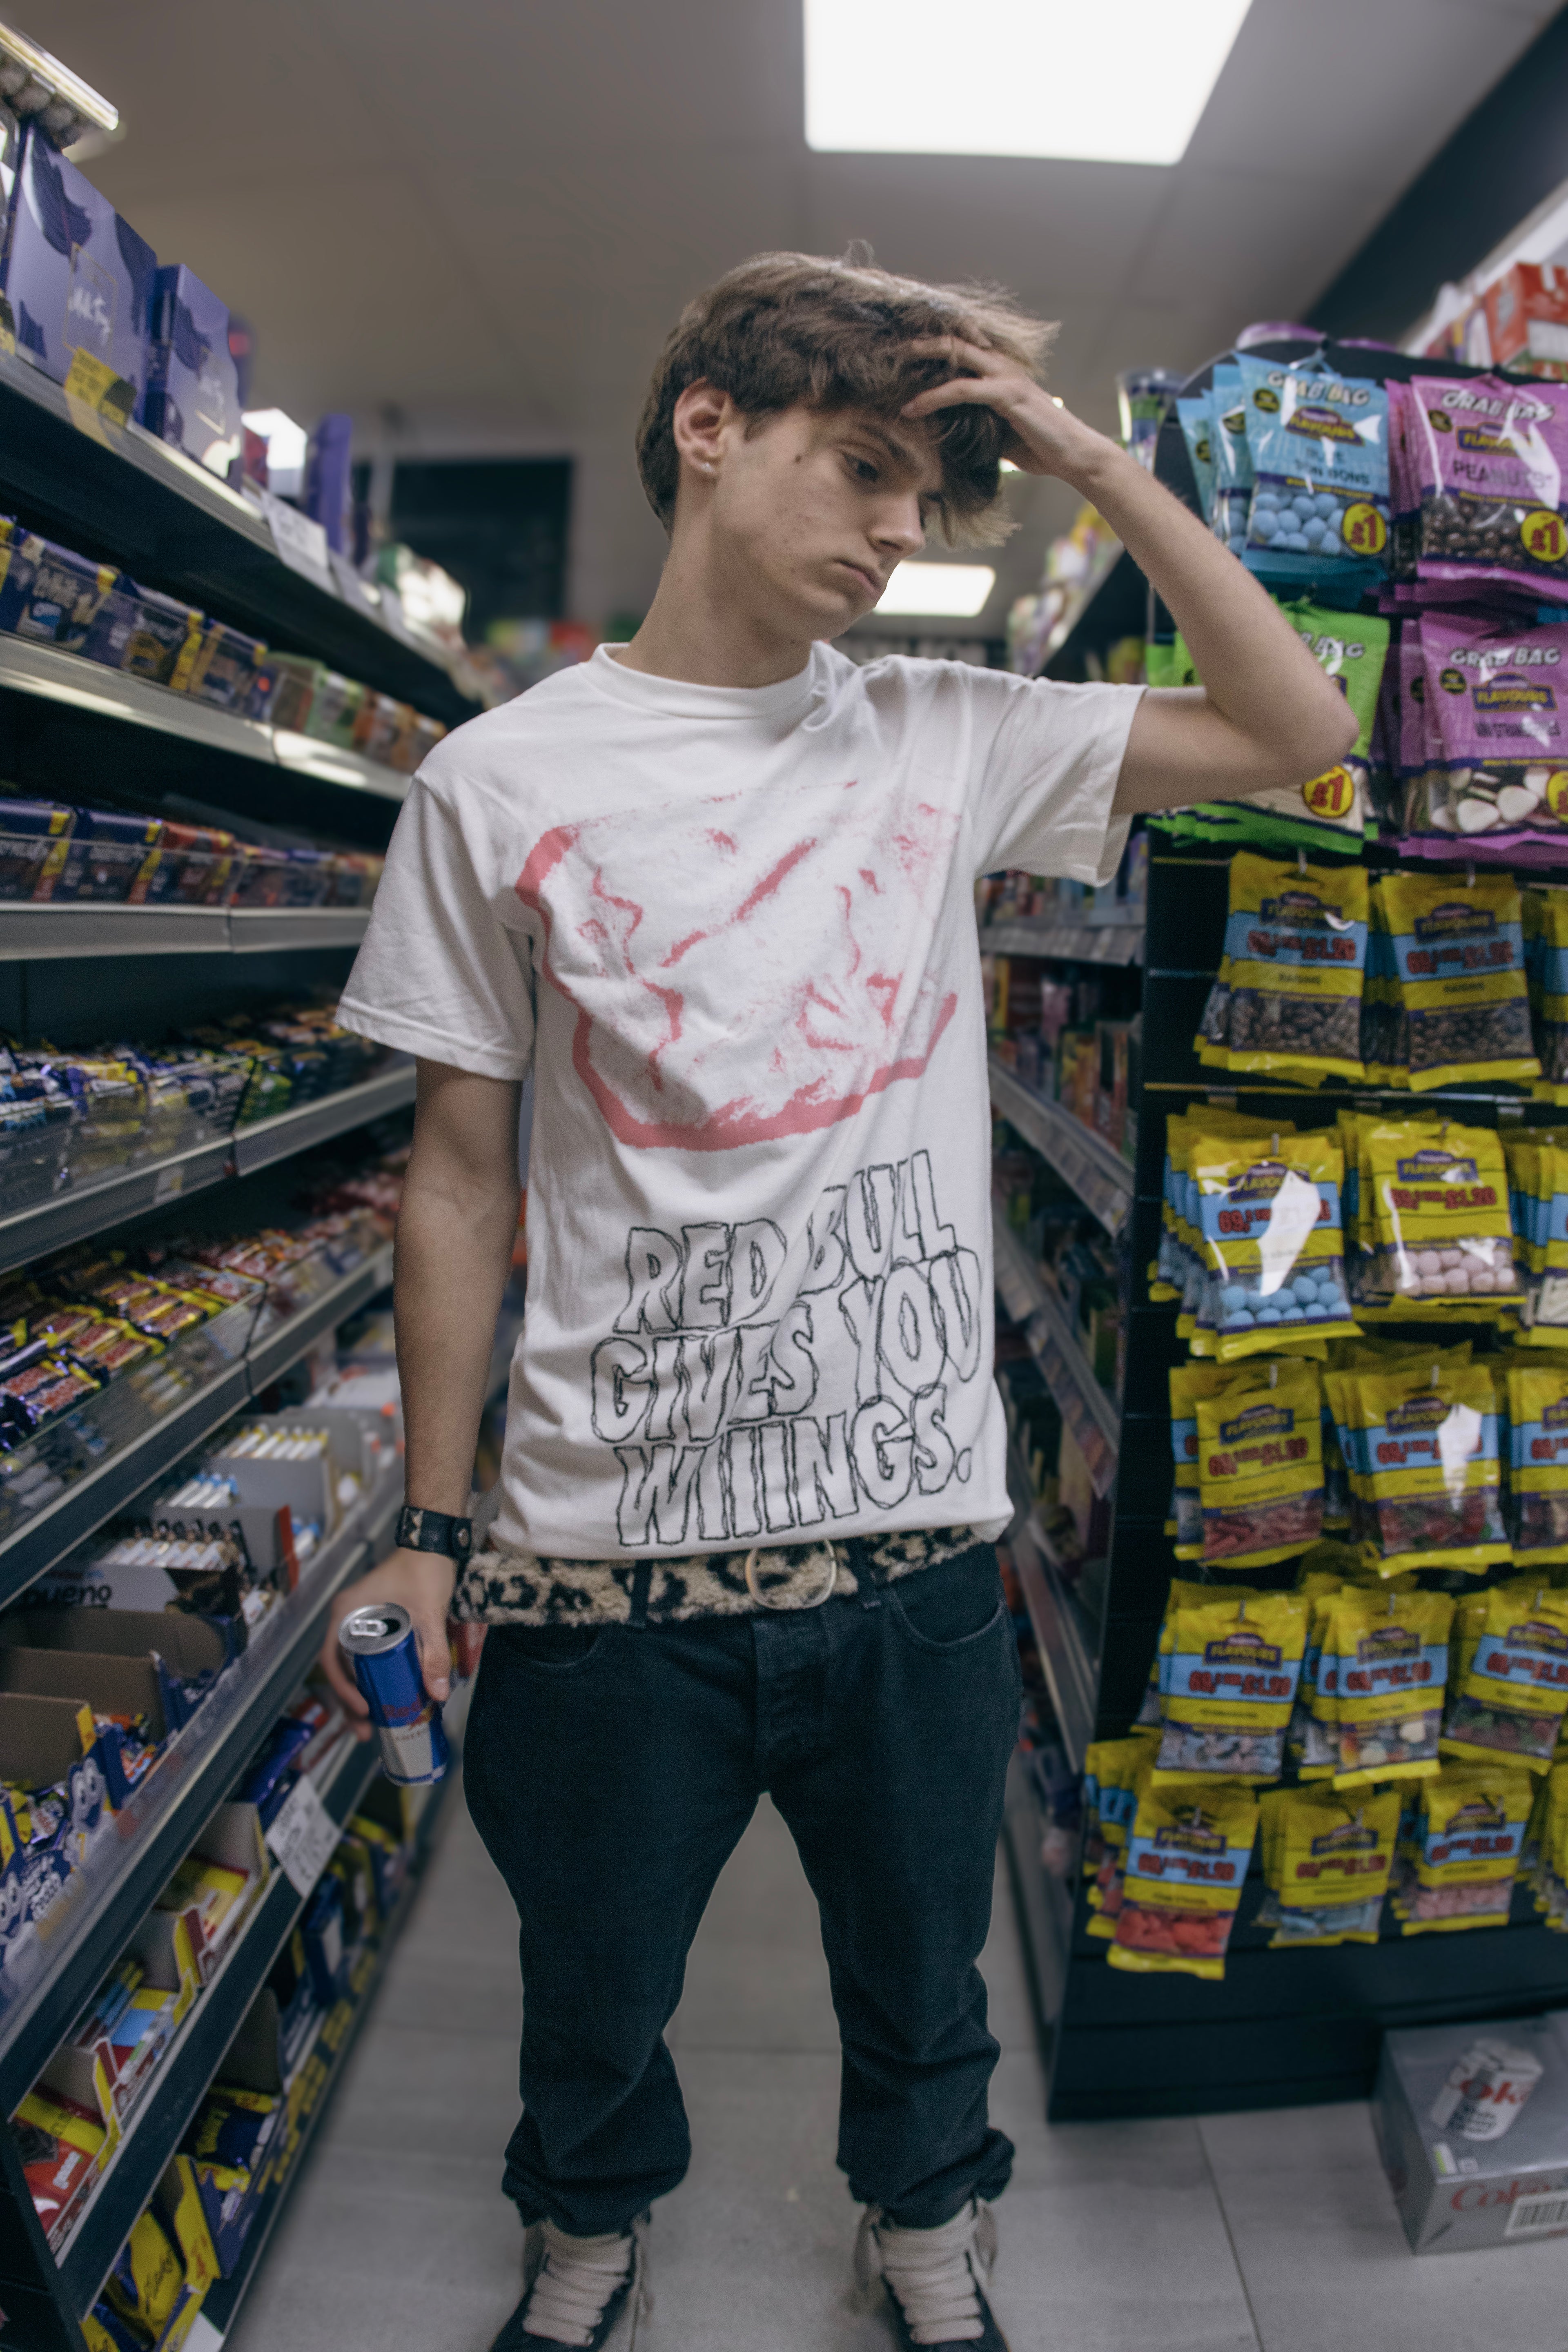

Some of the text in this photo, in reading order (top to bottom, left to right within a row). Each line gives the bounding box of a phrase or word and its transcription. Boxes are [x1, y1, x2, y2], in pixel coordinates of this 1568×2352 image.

[1267, 370, 1326, 401] GAB
[1351, 514, 1376, 548] £1
[1531, 521, 1559, 554] £1
[1512, 645, 1561, 667] BAG
[1476, 689, 1549, 704] FLAVOURS
[1311, 775, 1344, 811] £1
[612, 1149, 958, 1335] RED BULL
[590, 1246, 981, 1444] GIVES YOU
[613, 1382, 973, 1547] WIIINGS.
[1210, 1645, 1277, 1661] FLAVOURS
